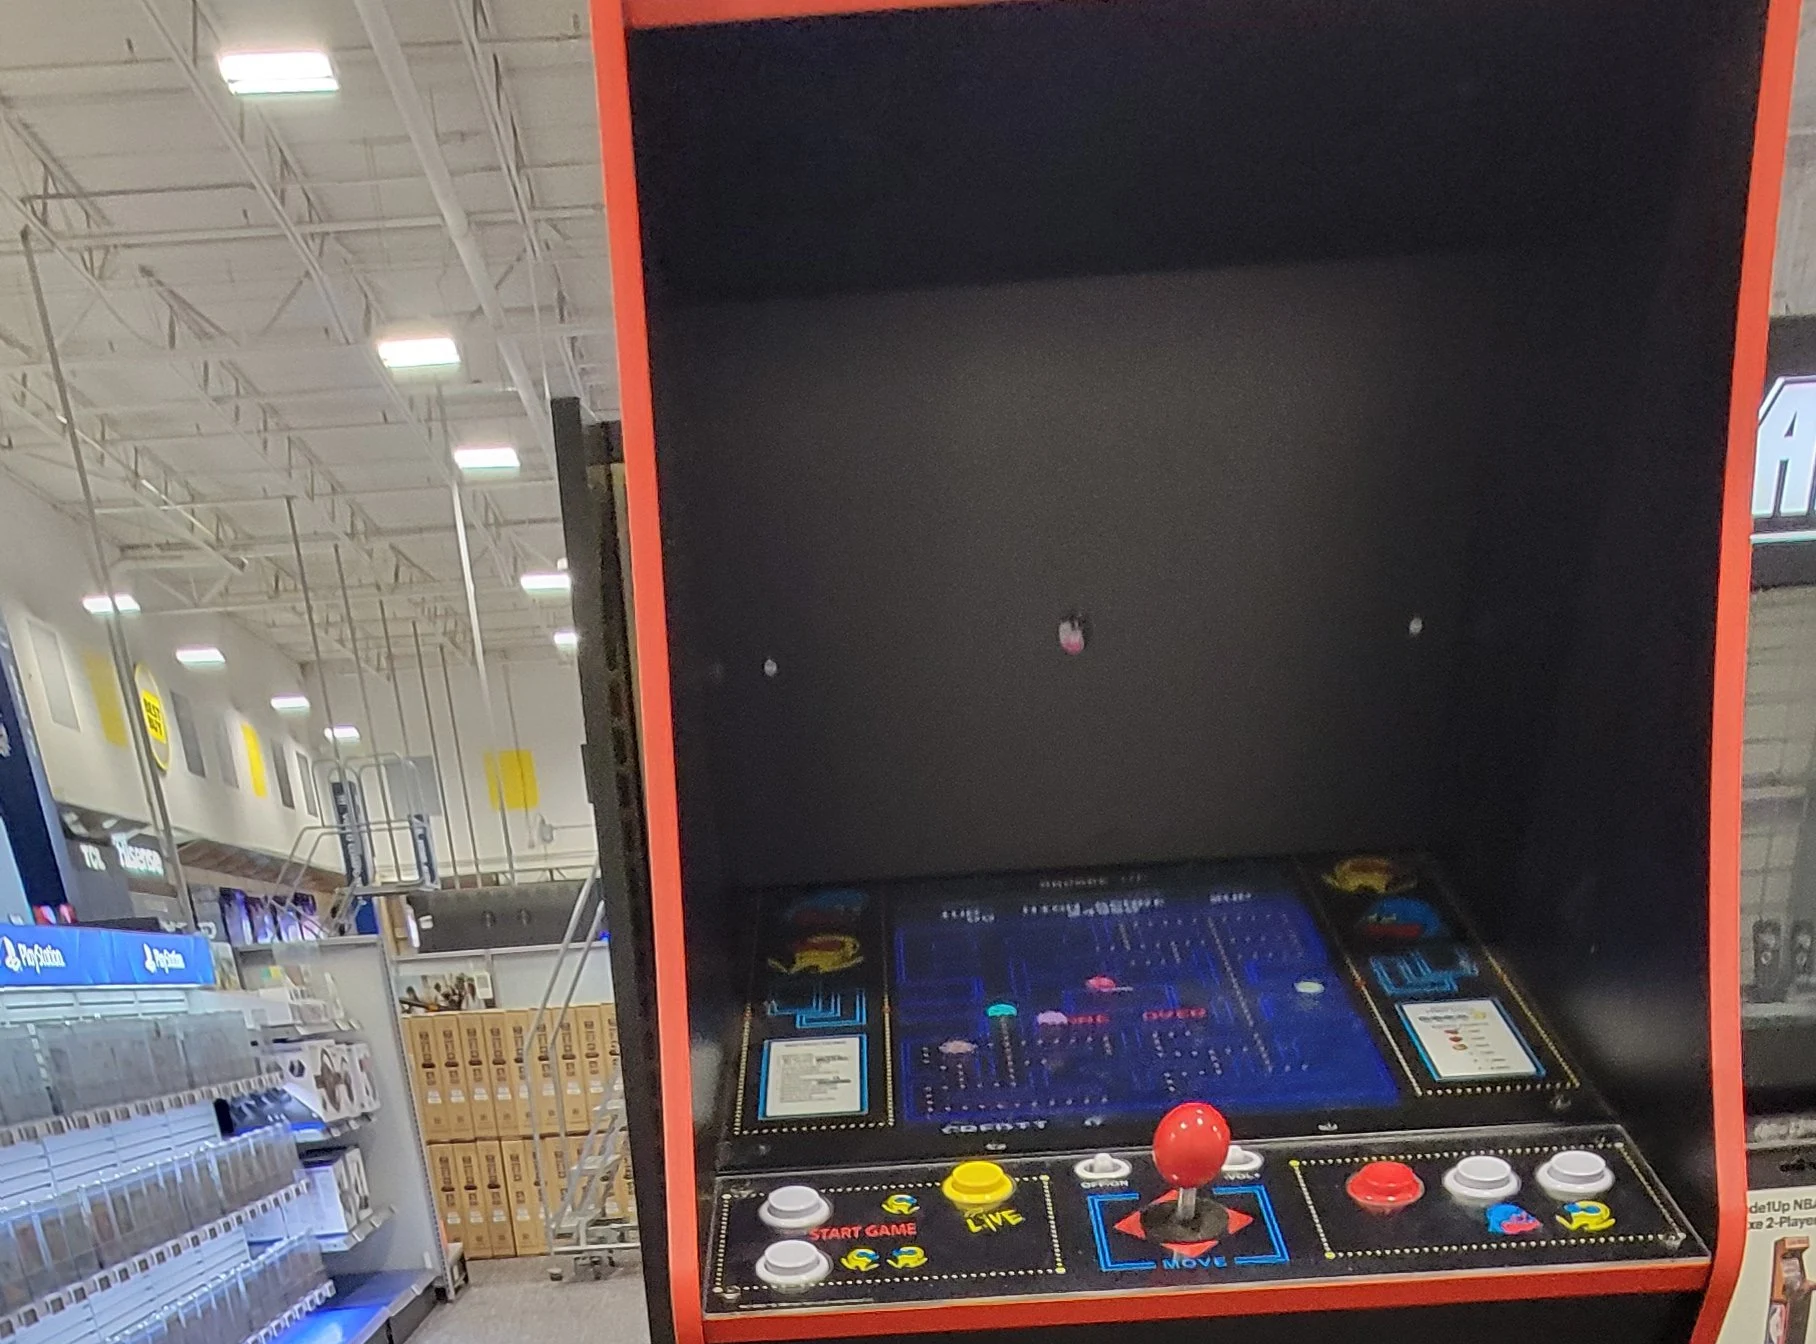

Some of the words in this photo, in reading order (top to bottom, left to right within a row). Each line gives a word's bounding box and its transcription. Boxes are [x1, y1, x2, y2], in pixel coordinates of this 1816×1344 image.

[1752, 376, 1816, 518] A
[111, 832, 165, 876] Hisense
[18, 944, 66, 974] PlayStation
[153, 948, 185, 974] PlayStation
[808, 1225, 862, 1241] START
[864, 1222, 917, 1238] GAME
[1766, 1215, 1816, 1230] 2-Playe
[1162, 1255, 1227, 1270] MOVE
